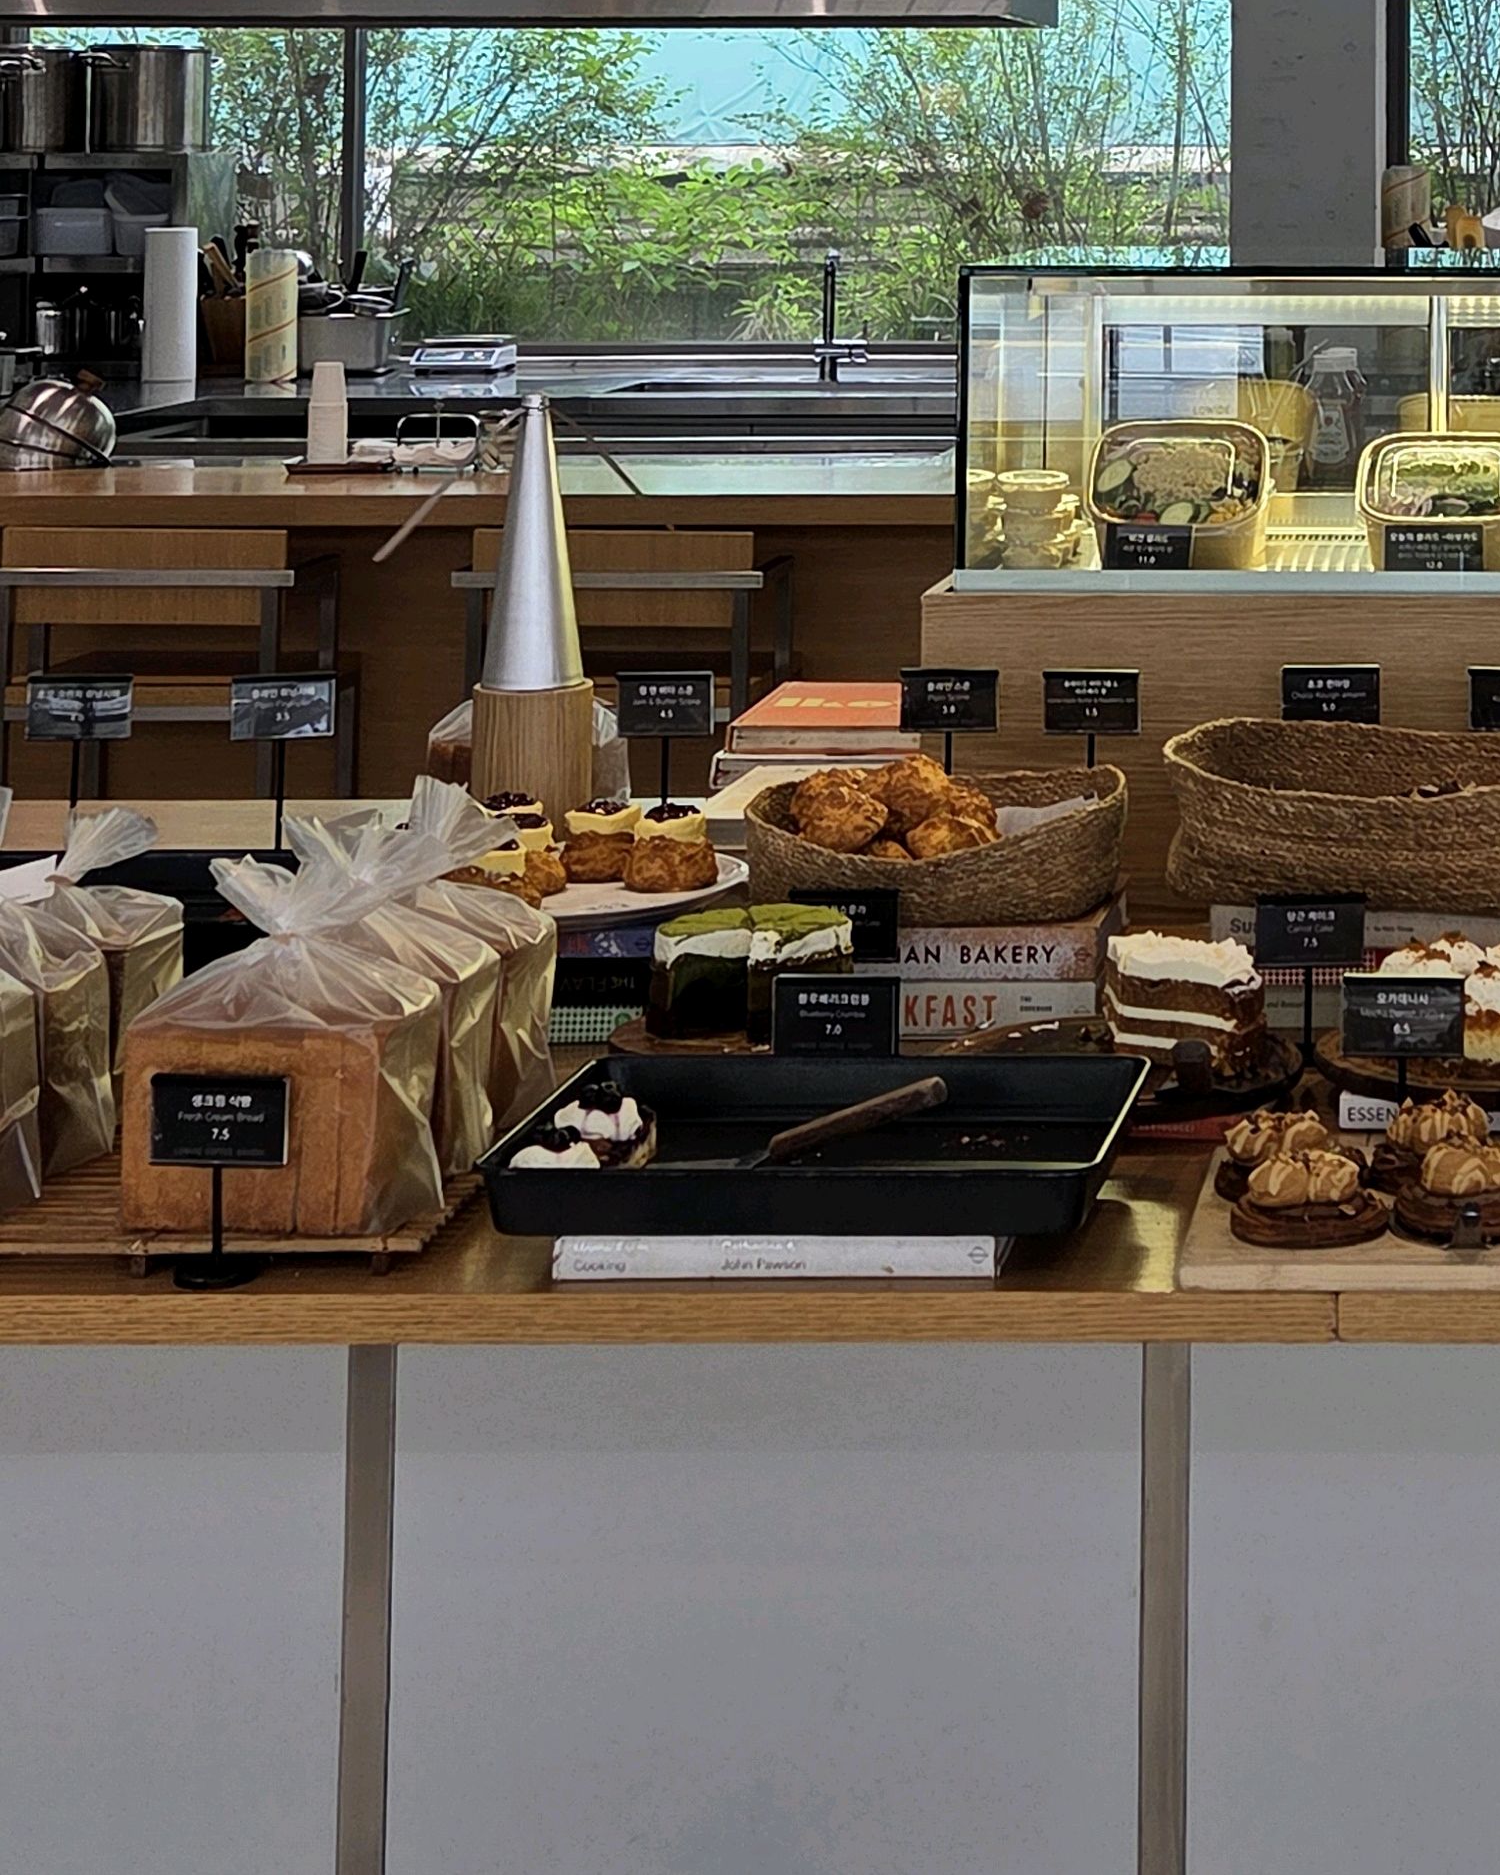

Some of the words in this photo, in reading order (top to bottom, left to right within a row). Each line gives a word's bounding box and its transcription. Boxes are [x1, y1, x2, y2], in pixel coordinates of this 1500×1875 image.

[959, 943, 1057, 965] BAKERY
[903, 994, 998, 1028] KFAST
[1347, 1106, 1398, 1122] ESSEN
